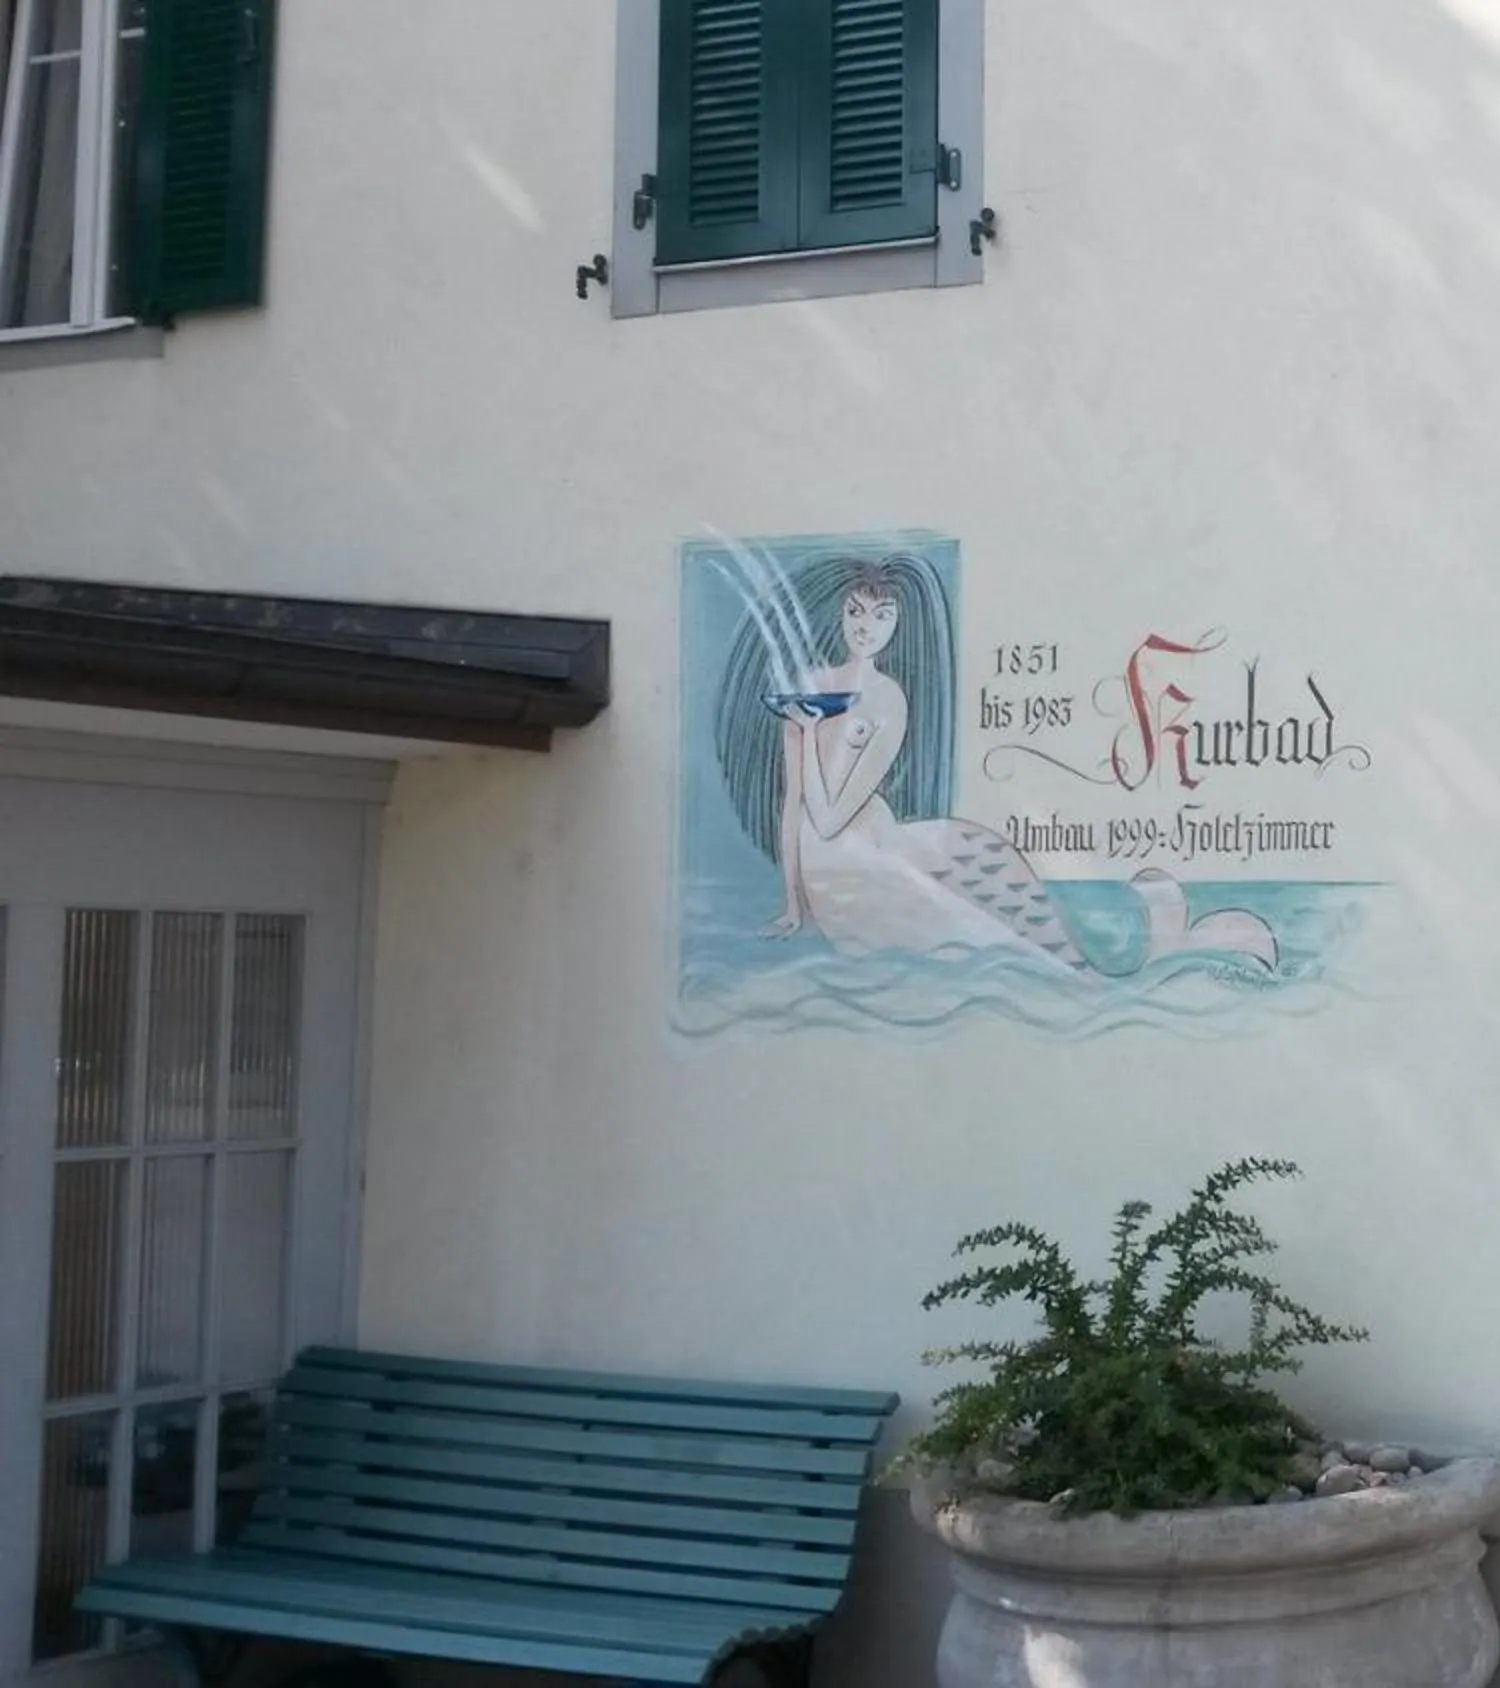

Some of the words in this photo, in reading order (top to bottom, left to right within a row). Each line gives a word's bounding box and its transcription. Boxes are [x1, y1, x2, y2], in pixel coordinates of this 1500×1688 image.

[993, 643, 1058, 675] 1851
[980, 686, 1013, 729] bis
[1023, 696, 1074, 735] 1983
[1093, 626, 1371, 791] Kurbad
[1006, 811, 1096, 852] Umbau
